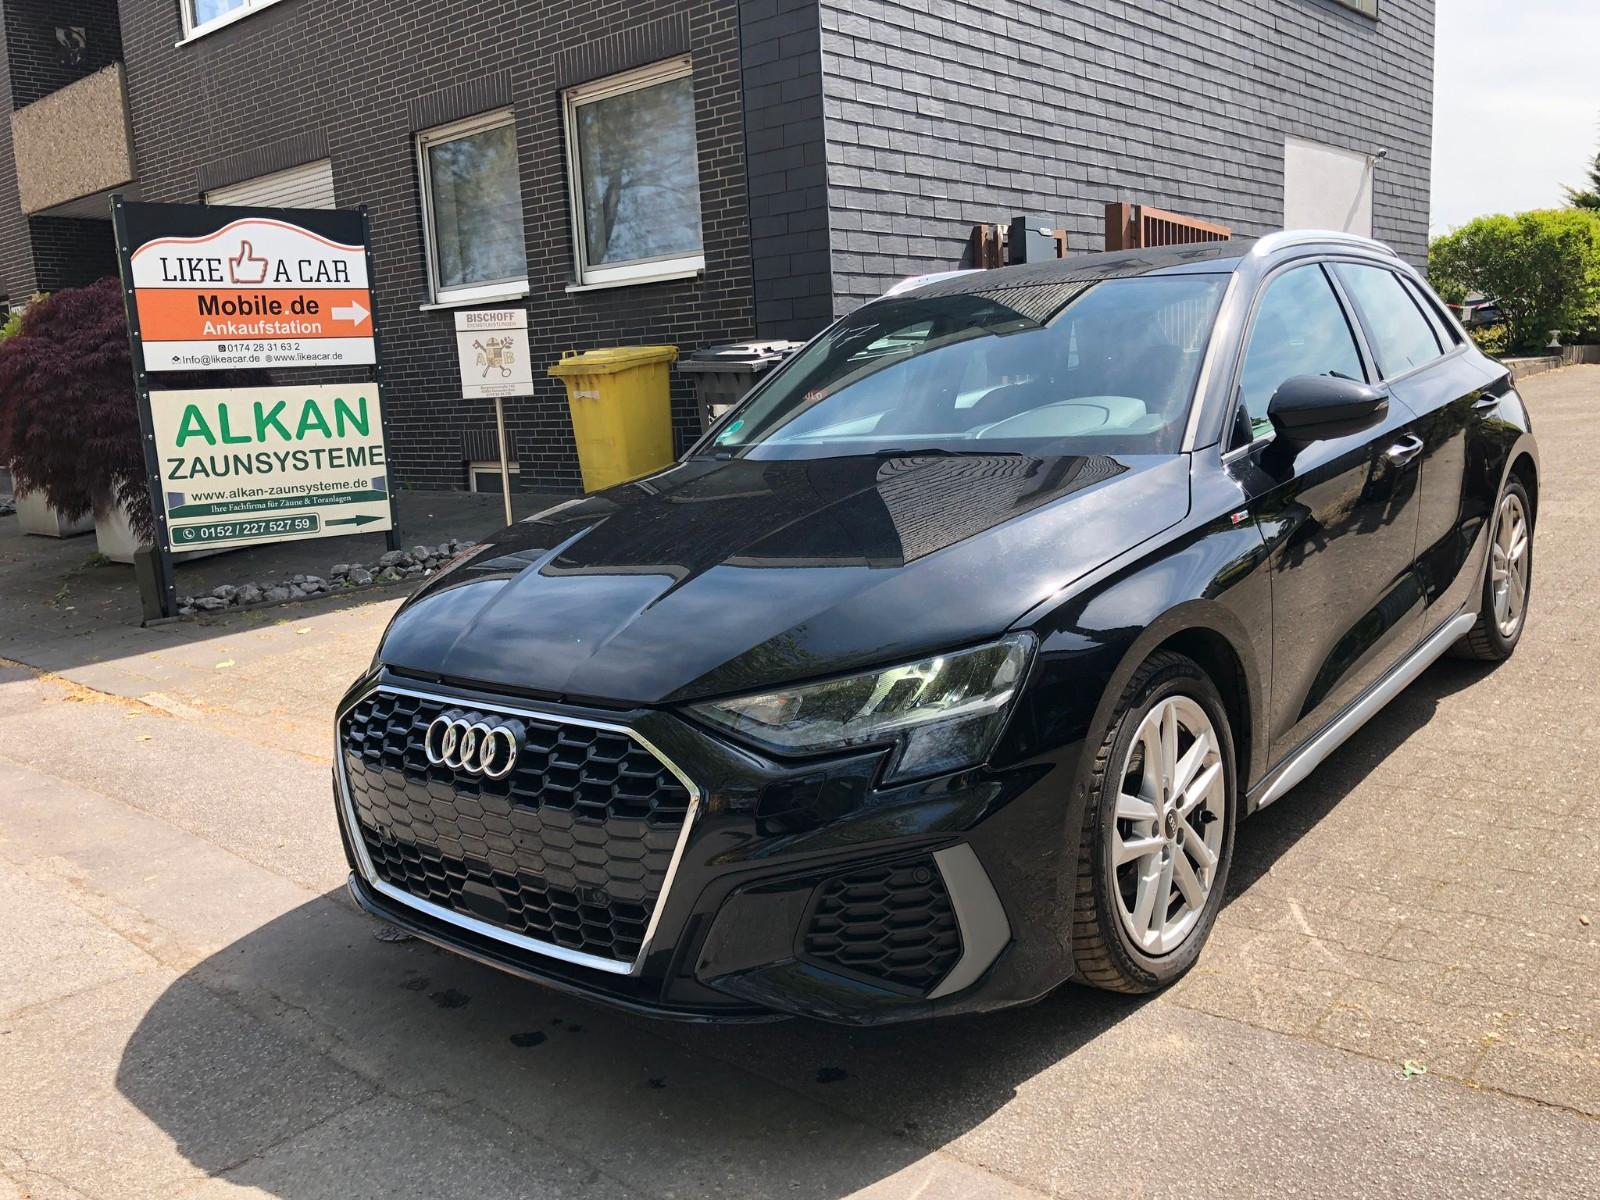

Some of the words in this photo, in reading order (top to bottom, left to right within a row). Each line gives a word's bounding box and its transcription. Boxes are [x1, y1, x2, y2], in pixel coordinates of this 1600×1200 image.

[159, 257, 224, 283] LIKE
[273, 259, 292, 283] A
[299, 259, 351, 283] CAR
[197, 294, 320, 316] Mobile.de
[202, 320, 322, 336] Ankaufstation
[466, 312, 515, 323] BISCHOFF
[227, 343, 250, 353] 0174
[253, 343, 265, 352] 28
[267, 343, 278, 352] 31
[280, 342, 292, 351] 63
[294, 342, 301, 351] 2
[182, 354, 260, 366] Info@likeacar.de
[273, 352, 343, 362] www.likeacar.de
[175, 396, 370, 448] ALKAN
[167, 445, 385, 480] ZAUNSYSTEME
[191, 478, 368, 502] www.alkan-zaunsysteme.de
[211, 504, 228, 513] Ihre
[228, 501, 266, 511] Fachfirma
[267, 500, 279, 508] für
[280, 499, 303, 507] Zäune
[304, 497, 311, 505] &
[312, 494, 352, 505] Toranlagen
[200, 525, 233, 539] 0152
[243, 522, 266, 535] 227
[269, 519, 292, 532] 527
[295, 518, 310, 530] 59
